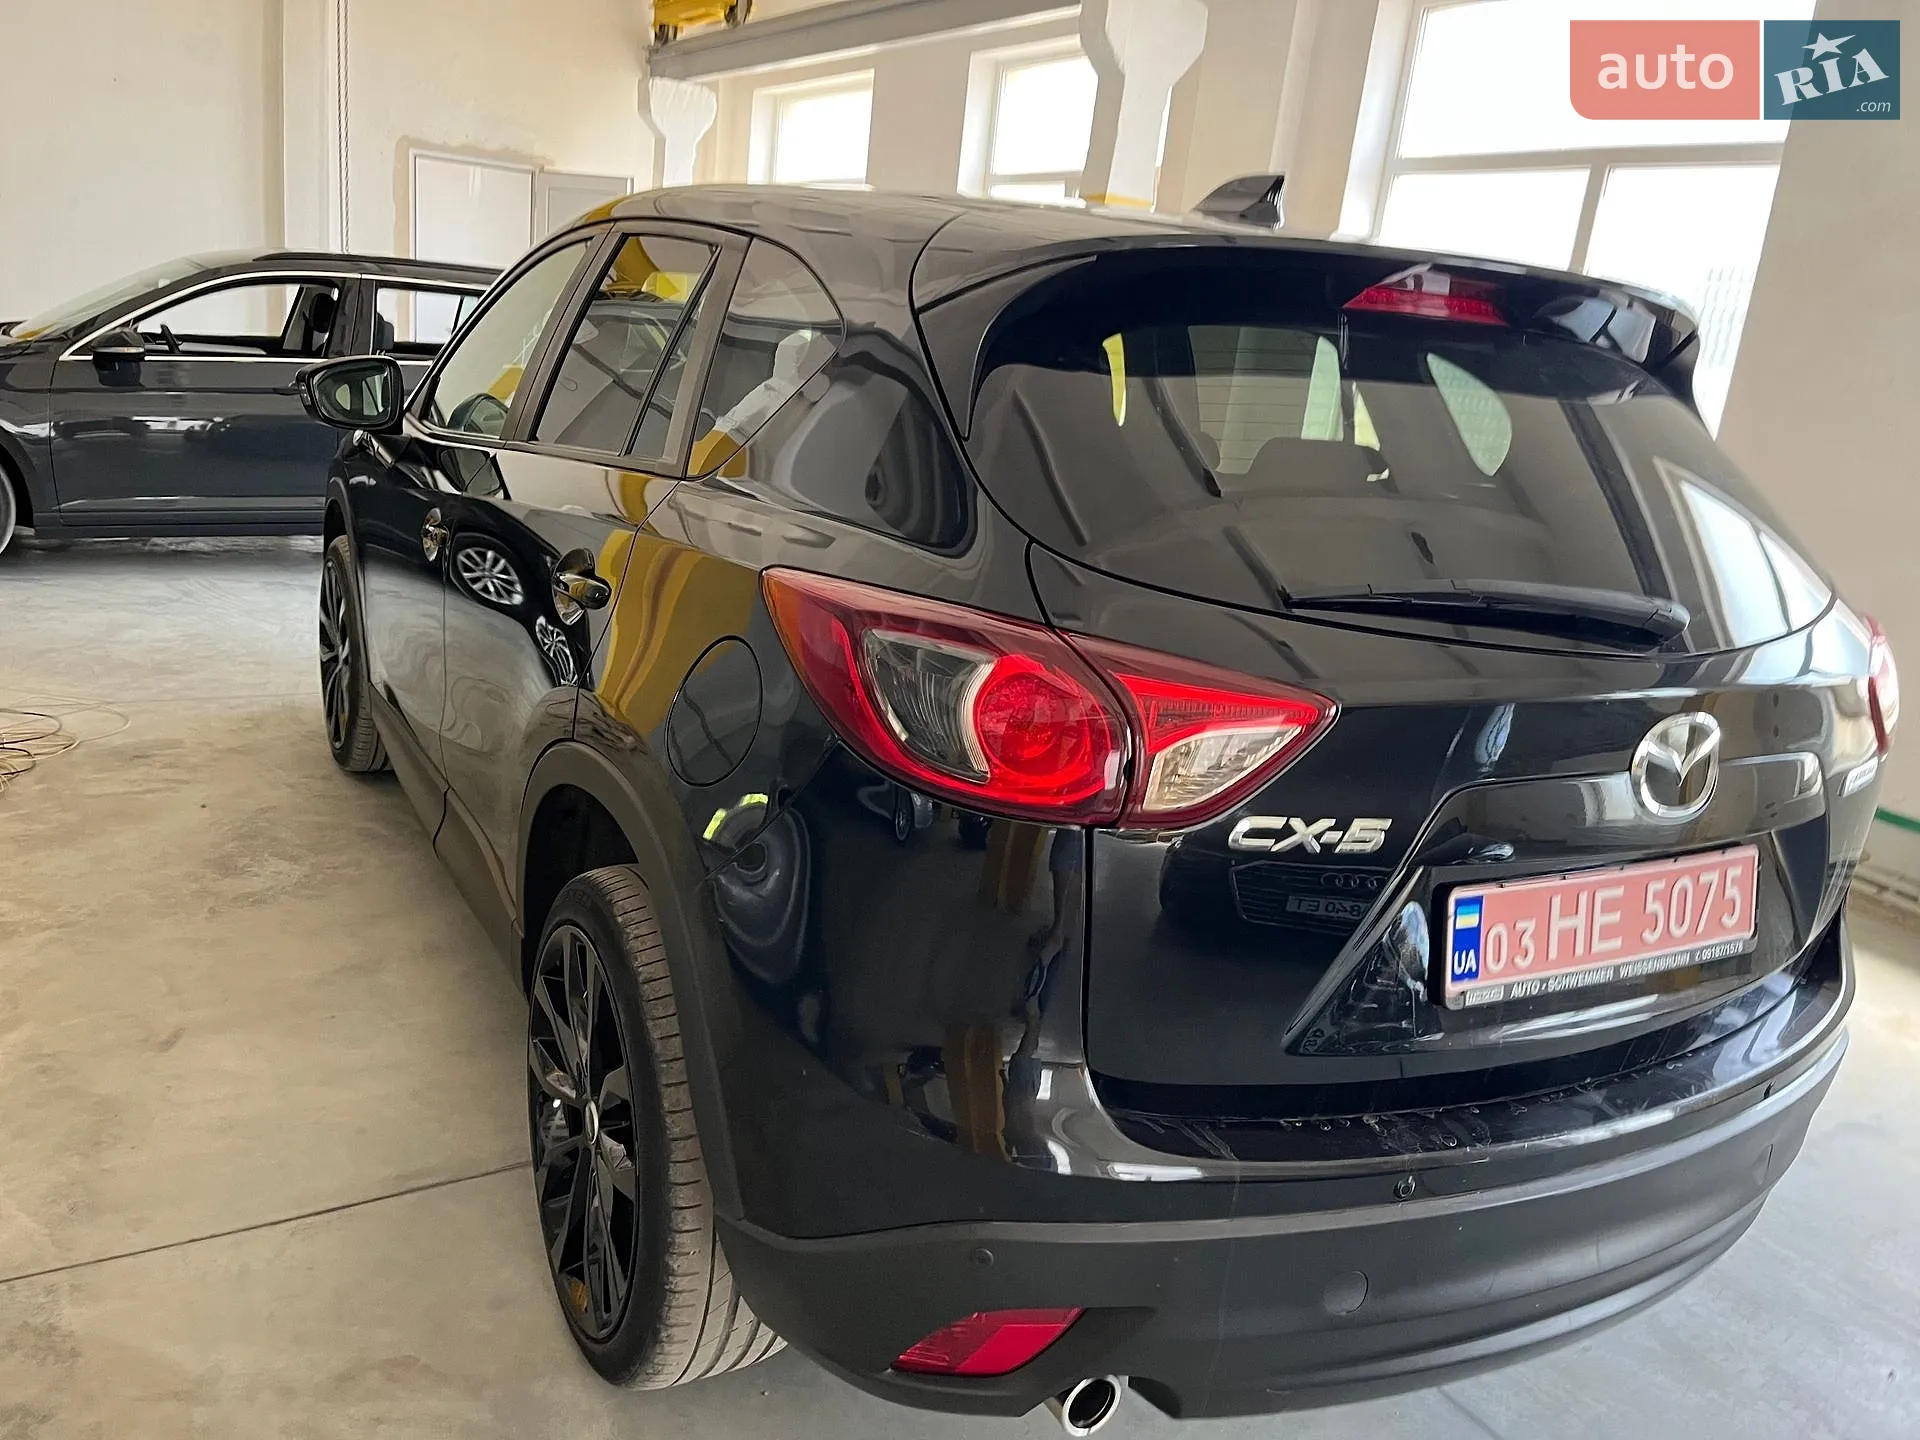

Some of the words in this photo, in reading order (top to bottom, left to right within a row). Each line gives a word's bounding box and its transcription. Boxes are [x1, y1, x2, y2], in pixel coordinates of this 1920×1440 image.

[1228, 816, 1392, 853] CX-5
[1485, 917, 1537, 974] 03
[1548, 885, 1625, 961] HE
[1640, 866, 1743, 945] 5075
[1453, 949, 1477, 975] UA
